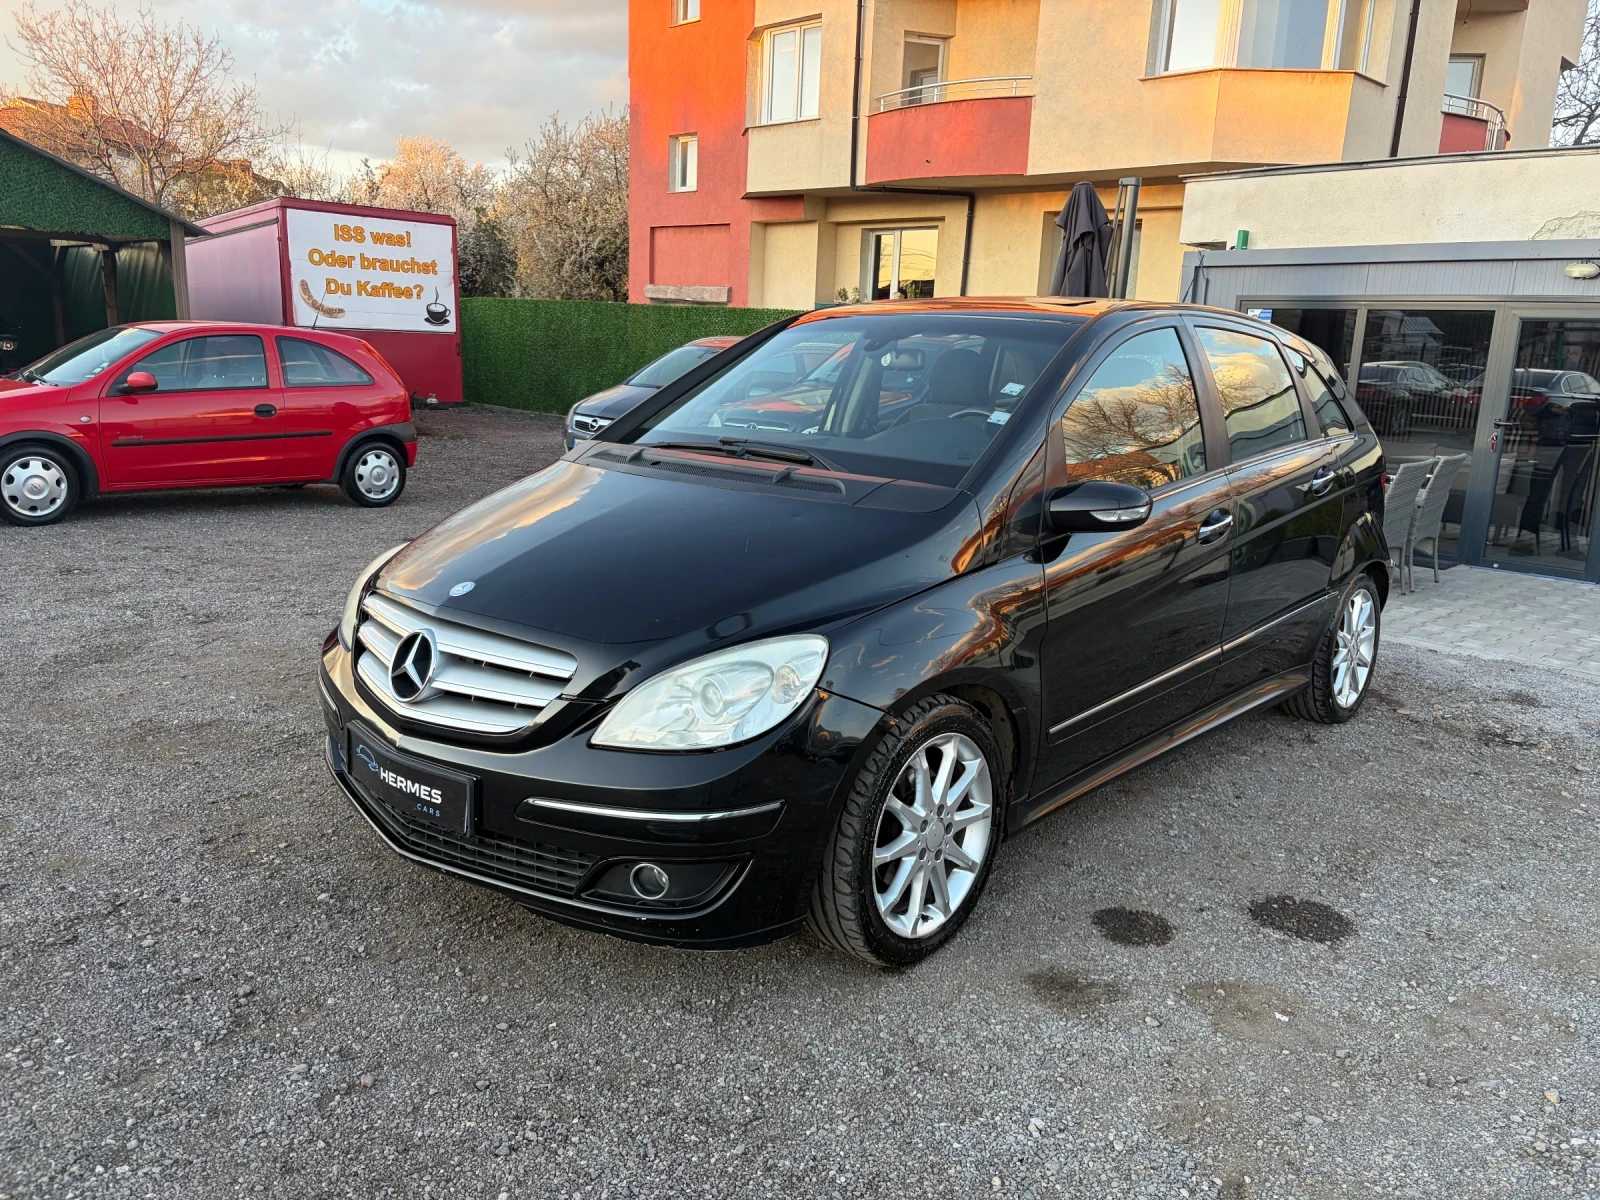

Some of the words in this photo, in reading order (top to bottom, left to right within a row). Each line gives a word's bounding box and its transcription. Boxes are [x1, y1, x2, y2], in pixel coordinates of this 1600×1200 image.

[334, 224, 366, 243] ISS
[370, 231, 412, 247] was!
[308, 248, 356, 268] Oder
[360, 253, 438, 275] brauchst
[326, 278, 352, 295] Du
[356, 280, 424, 299] Kaffee?
[380, 767, 442, 804] HERMES
[416, 803, 440, 817] CARS
